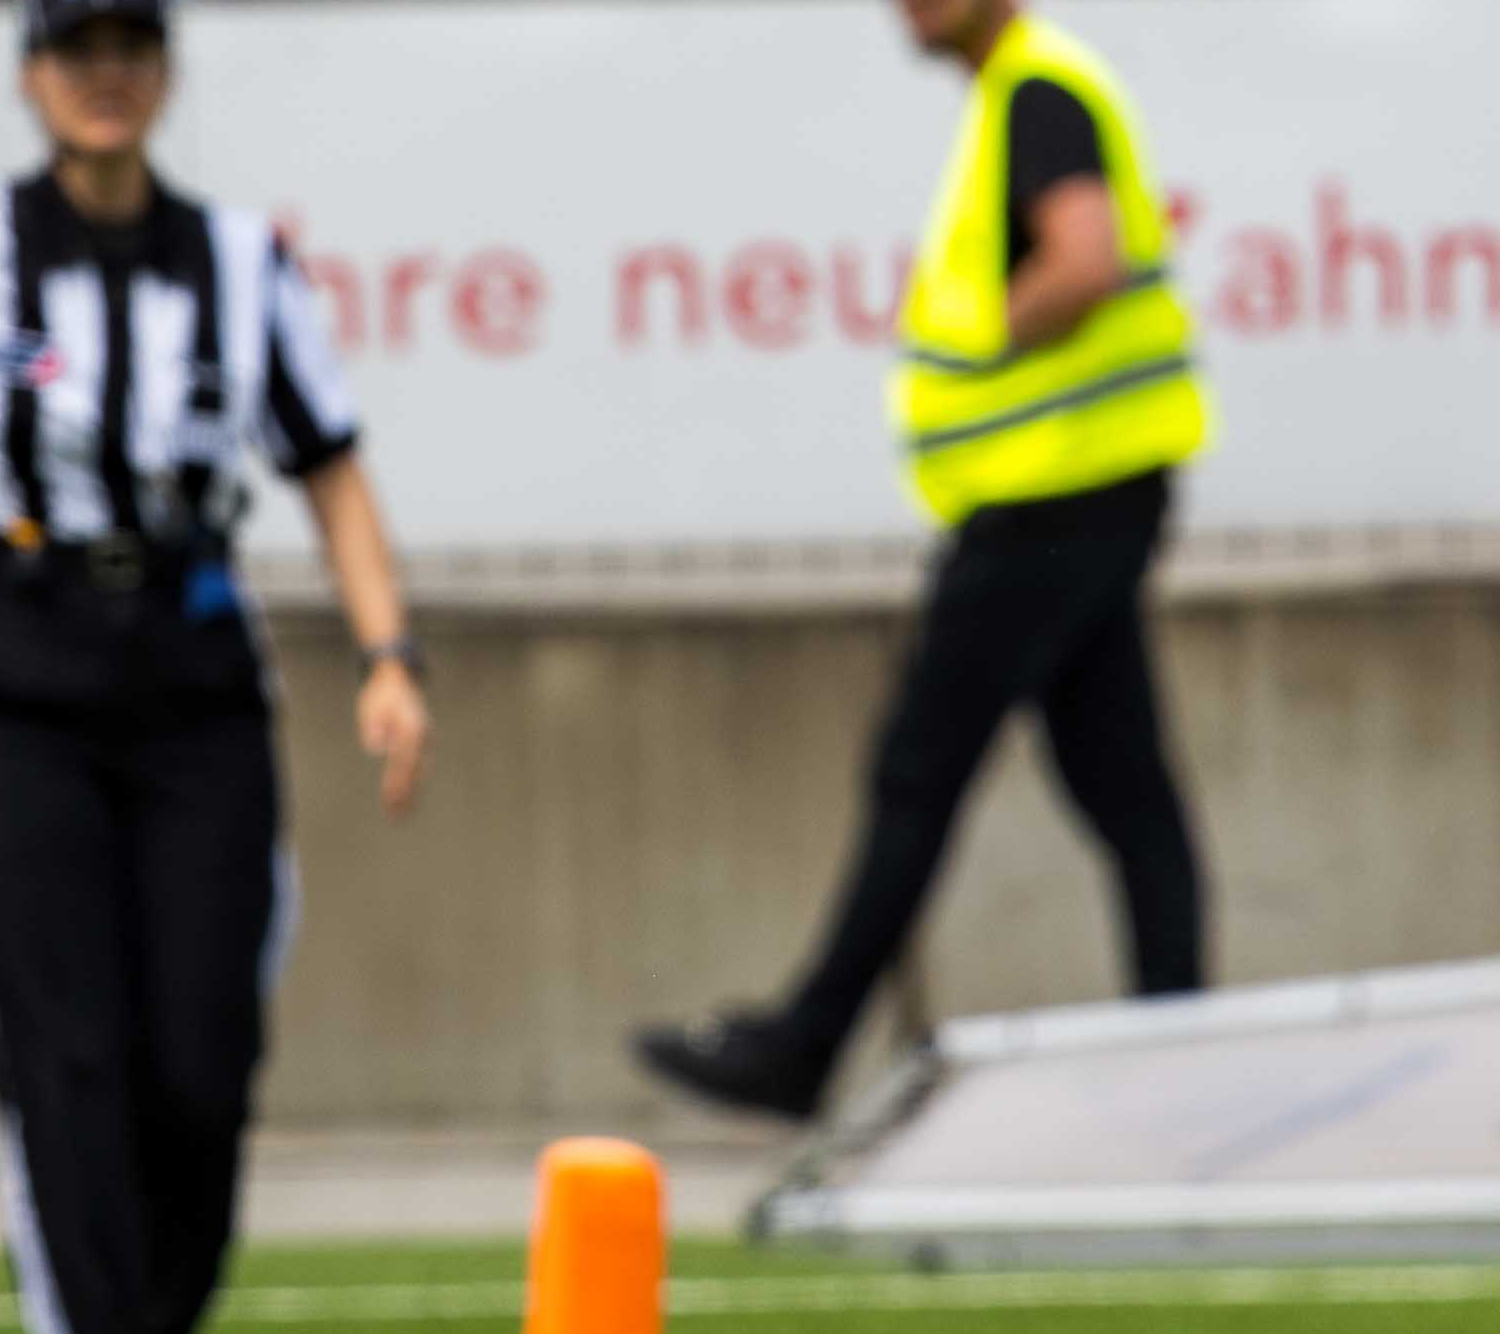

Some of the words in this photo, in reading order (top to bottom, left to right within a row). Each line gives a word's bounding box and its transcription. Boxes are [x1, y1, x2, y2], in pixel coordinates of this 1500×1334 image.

[276, 197, 548, 359] hre
[614, 232, 905, 349] neu
[1167, 175, 1500, 337] ahn
